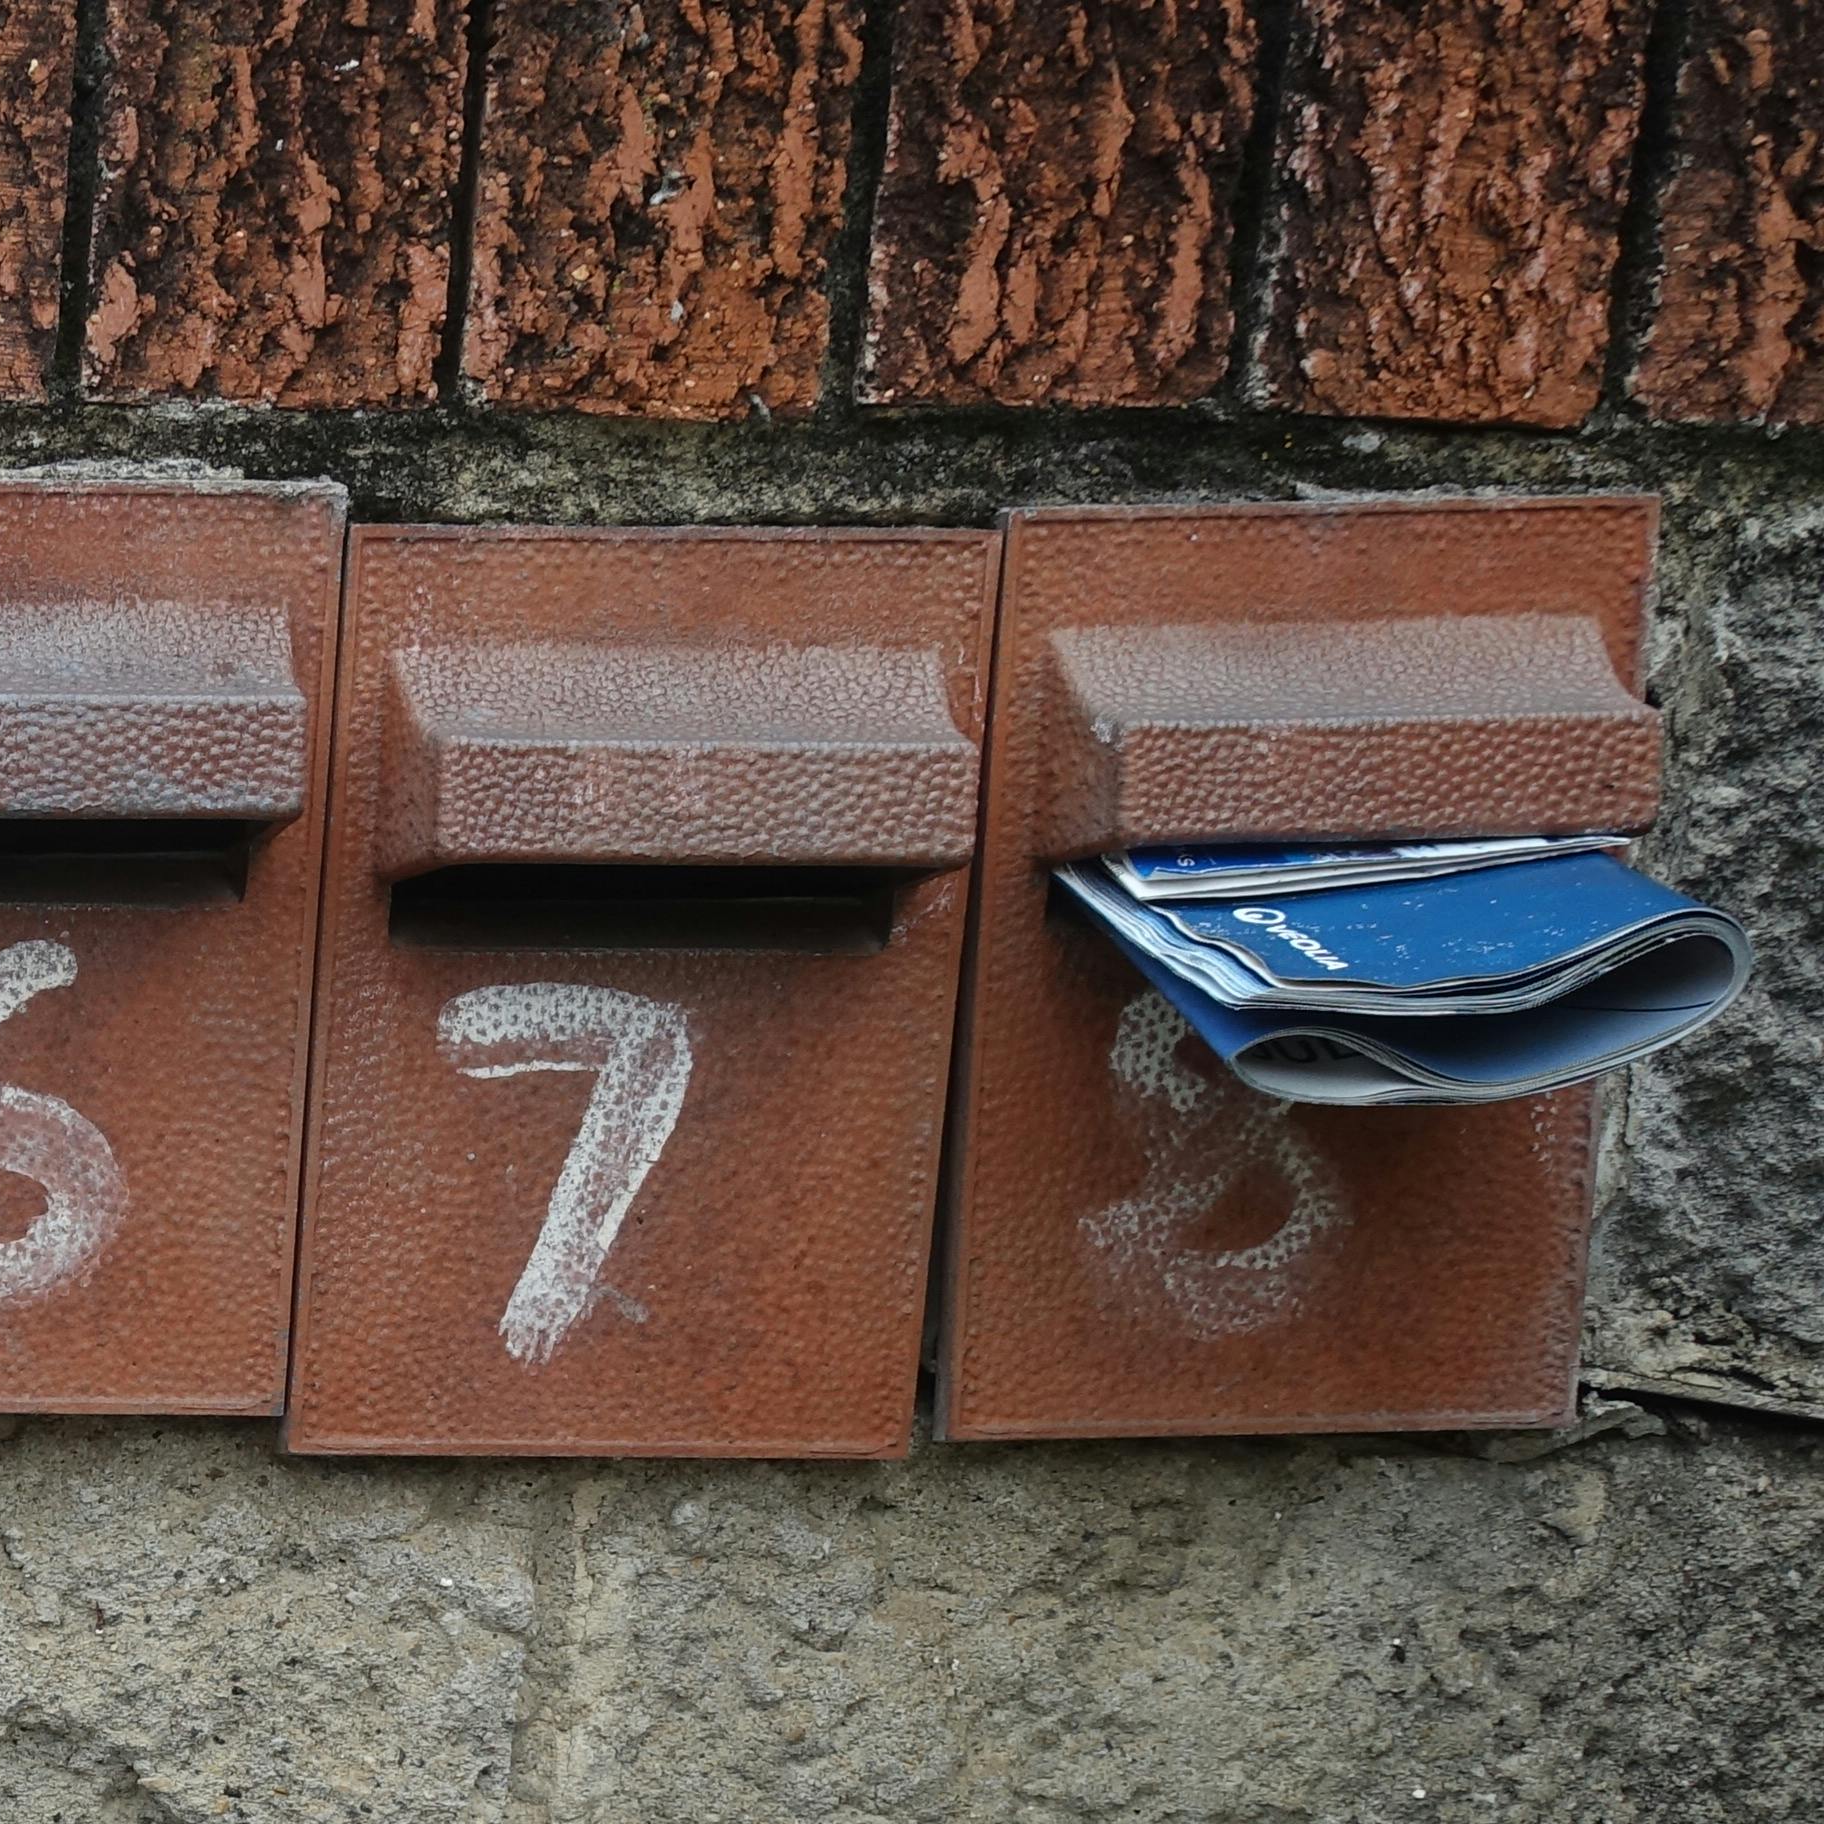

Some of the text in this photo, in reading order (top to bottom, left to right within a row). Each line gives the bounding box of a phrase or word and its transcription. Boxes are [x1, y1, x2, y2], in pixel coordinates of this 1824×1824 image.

[1266, 924, 1349, 970] VEOLIA
[436, 980, 694, 1366] 7
[1076, 990, 1352, 1344] 8
